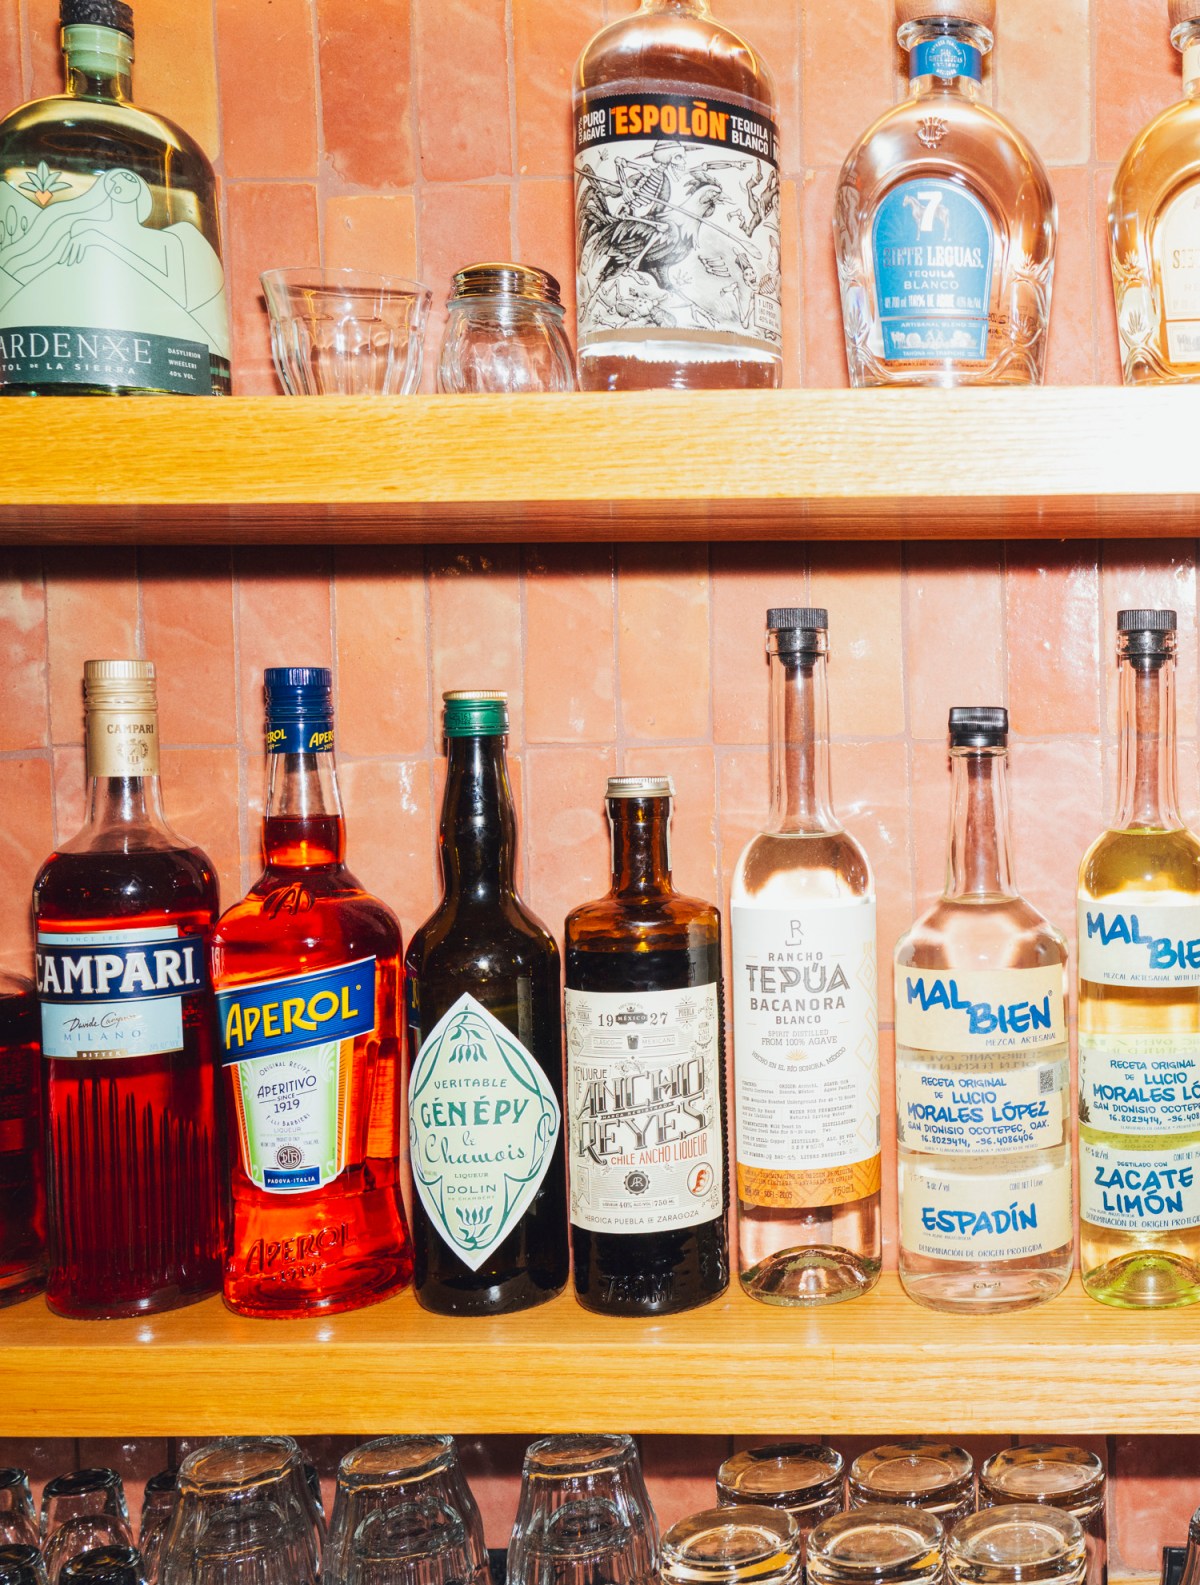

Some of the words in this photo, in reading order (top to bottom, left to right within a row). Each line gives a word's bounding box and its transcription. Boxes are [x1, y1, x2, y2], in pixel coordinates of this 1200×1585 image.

[583, 109, 606, 125] PURO
[730, 115, 768, 141] TEQUILA
[583, 125, 606, 143] AGAVE
[731, 131, 769, 155] BLANCO
[917, 191, 943, 232] 7
[883, 246, 923, 268] SIETE
[927, 245, 984, 269] LEGUAS
[908, 270, 955, 278] TEQUILA
[904, 280, 960, 290] BLANCO
[167, 347, 202, 359] DASYLIRION
[46, 363, 63, 371] LA
[74, 363, 136, 375] SIERRA
[168, 359, 198, 370] WHEELERI
[1086, 911, 1153, 946] MAL
[768, 952, 823, 961] RANCHO
[746, 962, 850, 993] TEPÚA
[750, 996, 846, 1011] BACANORA
[906, 976, 971, 1011] MAL
[966, 995, 1051, 1034] BIEN
[225, 986, 359, 1050] APEROL
[598, 1014, 614, 1027] 19
[650, 1012, 668, 1026] 27
[775, 1015, 822, 1024] BLANCO
[64, 1030, 142, 1041] MILANO
[761, 1037, 783, 1046] FROM
[786, 1038, 806, 1046] 100%
[808, 1036, 838, 1045] AGAVE
[793, 1029, 829, 1038] DISTILLED
[985, 1038, 1016, 1047] MEZCAL
[259, 1061, 286, 1076] ORIGINAL
[1110, 1059, 1148, 1070] RECETA
[1151, 1059, 1196, 1070] ORIGINAL
[434, 1078, 508, 1089] VERITABLE
[921, 1076, 955, 1088] RECETA
[959, 1077, 1007, 1088] ORIGINAL
[1144, 1072, 1188, 1085] LUCIO
[257, 1075, 317, 1099] APERITIVO
[577, 1056, 705, 1120] ANCHO
[1092, 1083, 1175, 1102] MORALES
[274, 1098, 300, 1113] 1919
[934, 1091, 944, 1099] DE
[952, 1091, 997, 1105] LUCIO
[420, 1096, 529, 1128] GÉNÉPY
[907, 1102, 984, 1123] MORALES
[992, 1100, 1049, 1123] LÓPEZ
[1093, 1101, 1109, 1110] SAN
[1113, 1104, 1156, 1113] DIONISIO
[578, 1092, 713, 1165] REYES
[907, 1121, 921, 1131] SAN
[924, 1123, 964, 1135] DIONISIO
[968, 1123, 1026, 1135] OCOTEPEC,
[1030, 1119, 1050, 1130] OAX.
[425, 1134, 526, 1164] Chamois
[611, 1153, 636, 1165] CHILE
[639, 1145, 670, 1165] ANCHO
[674, 1133, 708, 1161] LIQUEUR
[1094, 1166, 1194, 1191] ZACATE
[447, 1185, 496, 1194] DOLIN
[1103, 1189, 1183, 1217] LIMÓN
[585, 1215, 612, 1224] HEROICA
[614, 1216, 645, 1225] PUEBLA
[657, 1210, 699, 1223] ZARAGOZA
[921, 1201, 1038, 1236] ESPADÍN
[246, 1223, 356, 1272] APEROL
